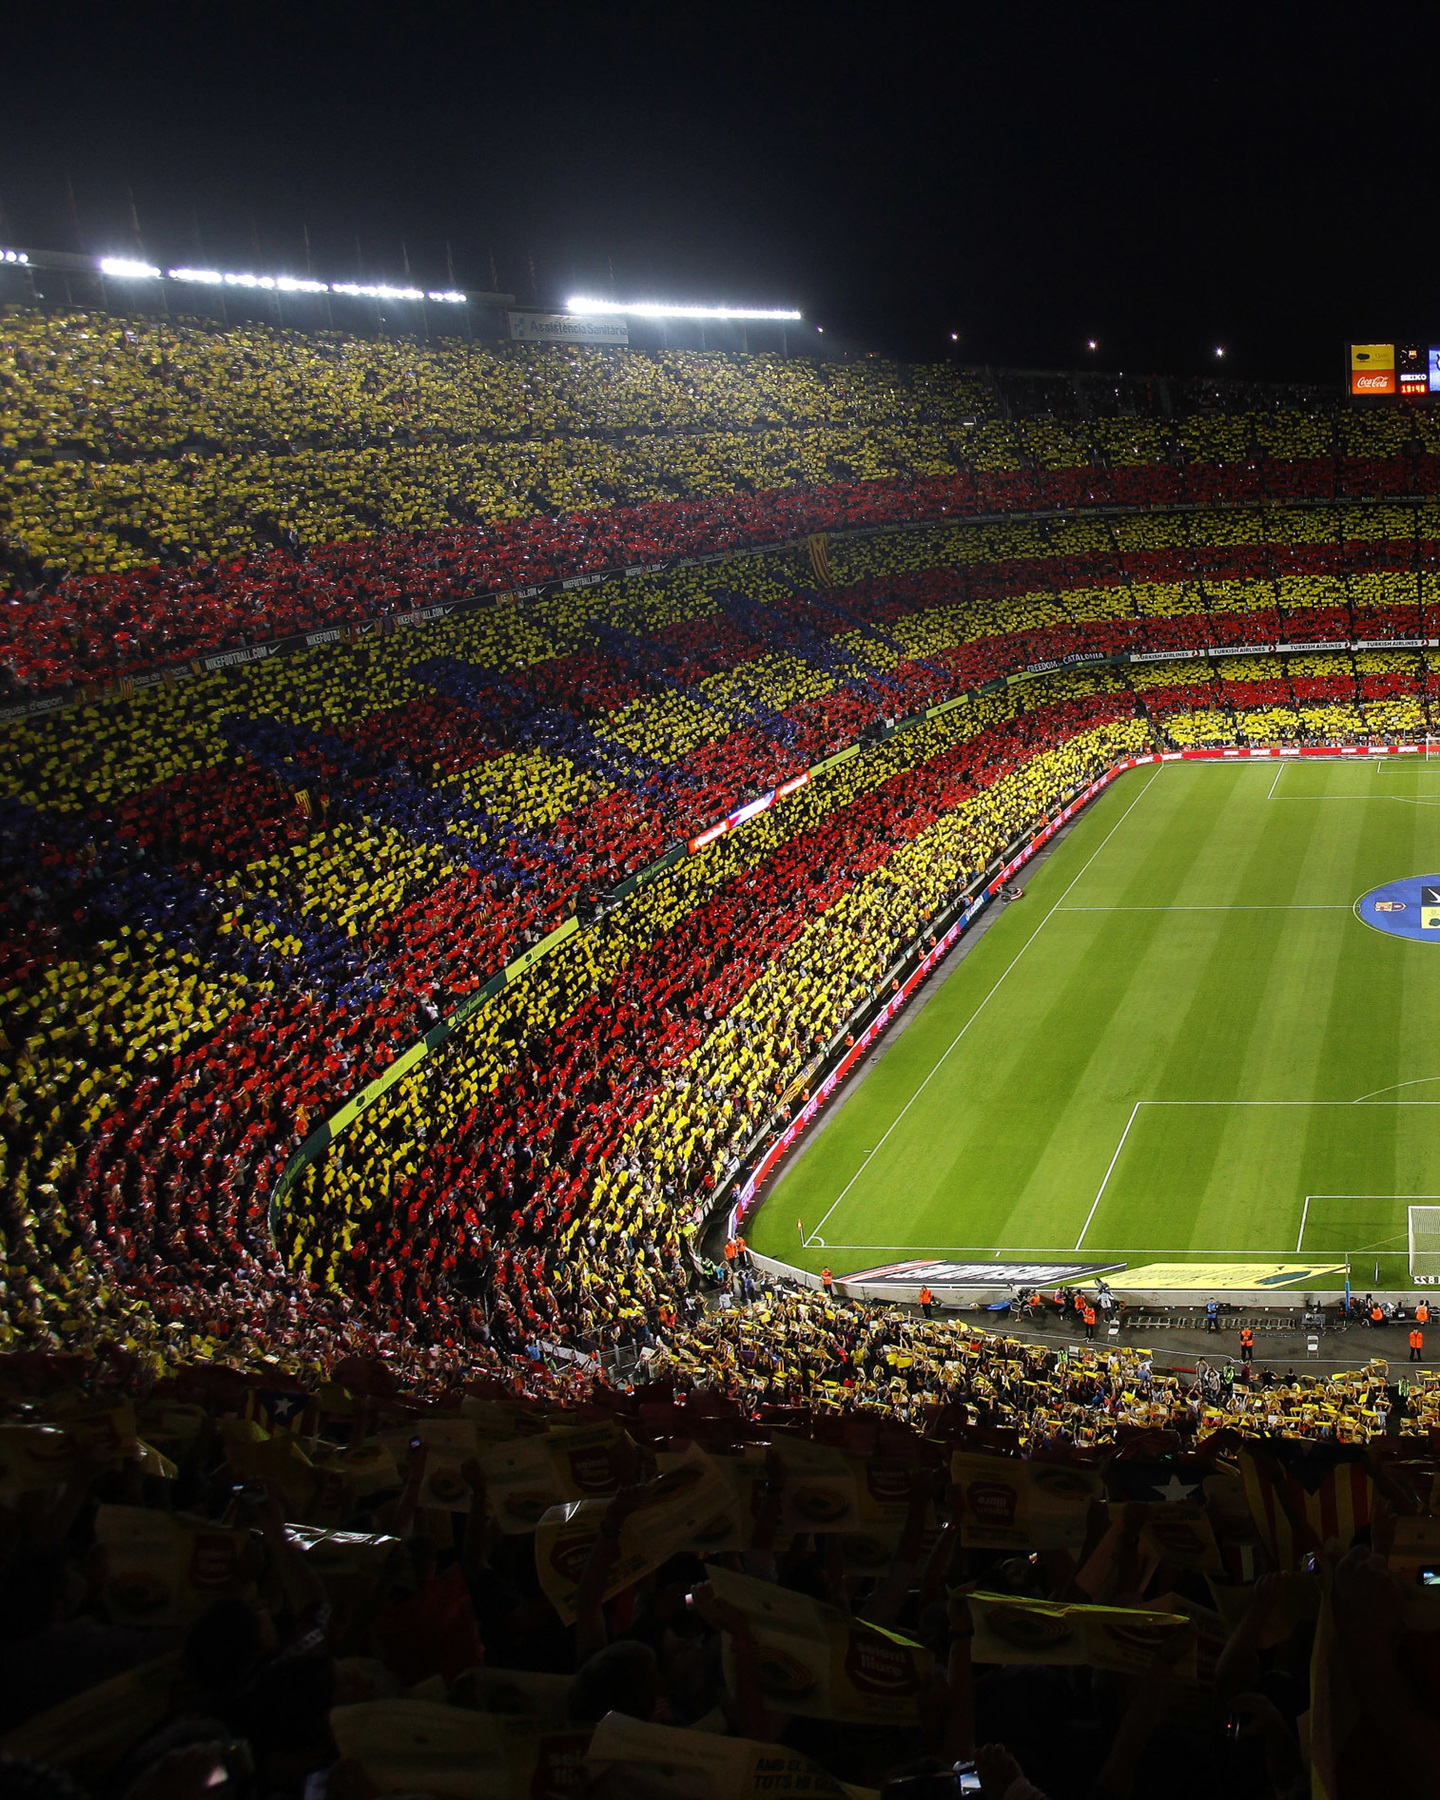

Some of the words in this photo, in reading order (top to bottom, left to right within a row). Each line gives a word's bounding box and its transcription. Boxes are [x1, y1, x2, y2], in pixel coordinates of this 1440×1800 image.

[205, 645, 267, 670] NIKEFOOTBALL.COM
[1026, 660, 1058, 673] FREEDOM
[1062, 652, 1105, 665] CATALONIA
[802, 1098, 818, 1122] SPORT
[856, 1642, 907, 1664] seient
[756, 1758, 784, 1772] AMB
[754, 1774, 791, 1790] TOTS
